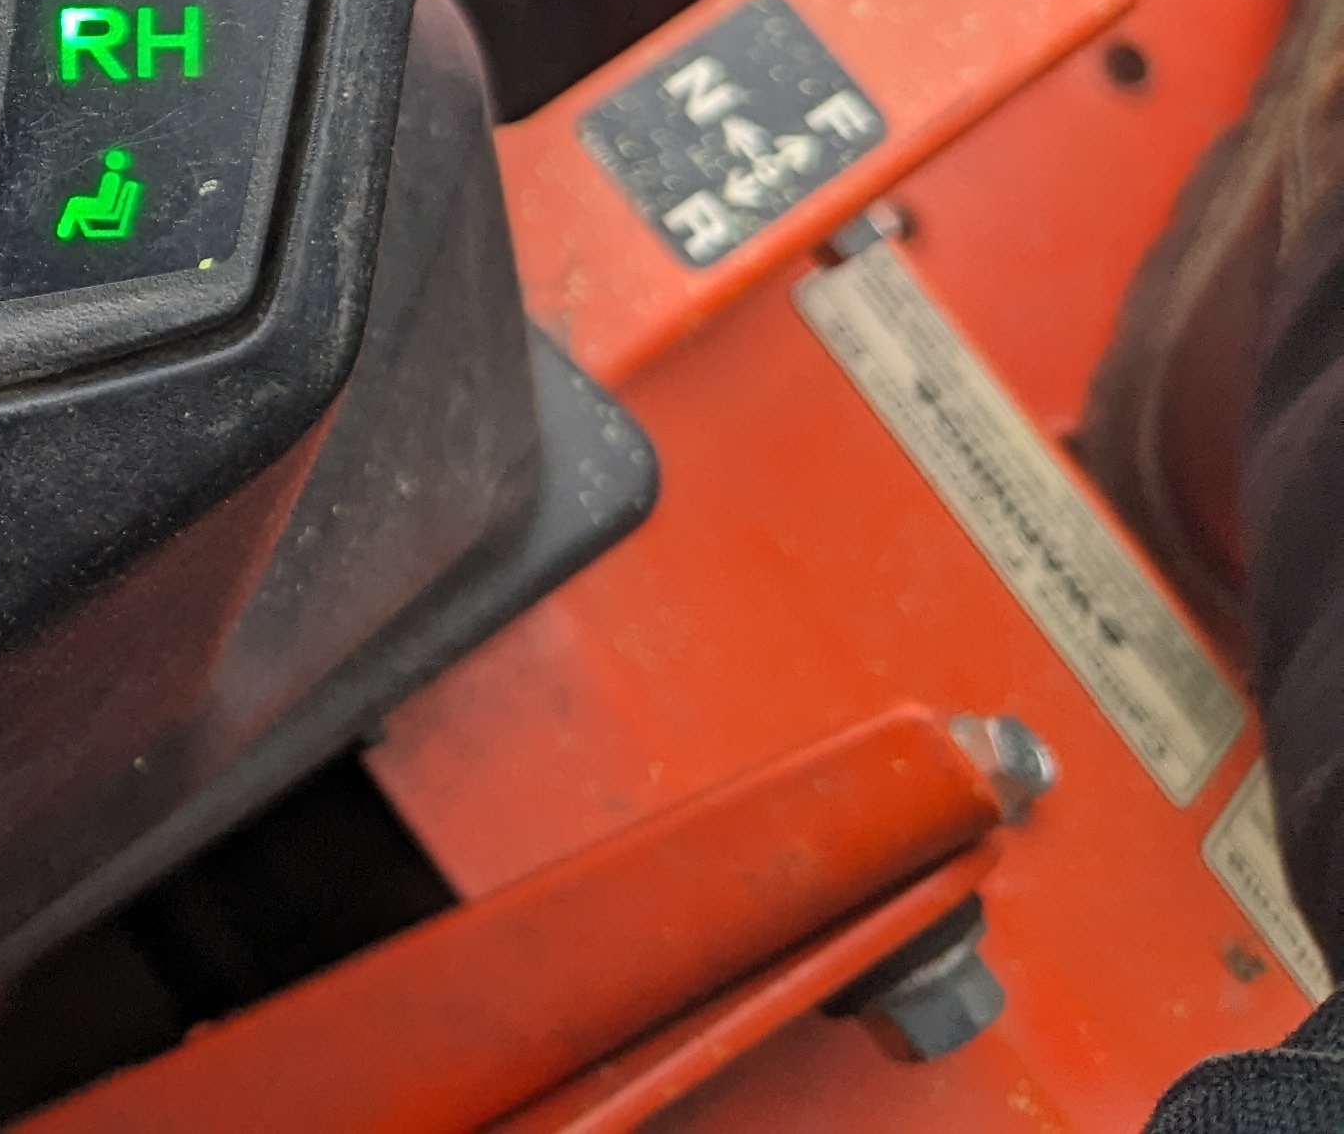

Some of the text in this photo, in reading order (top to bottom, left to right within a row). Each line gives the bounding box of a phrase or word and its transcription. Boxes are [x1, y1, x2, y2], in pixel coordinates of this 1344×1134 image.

[60, 5, 202, 81] RH
[804, 89, 882, 142] F
[663, 189, 740, 263] R
